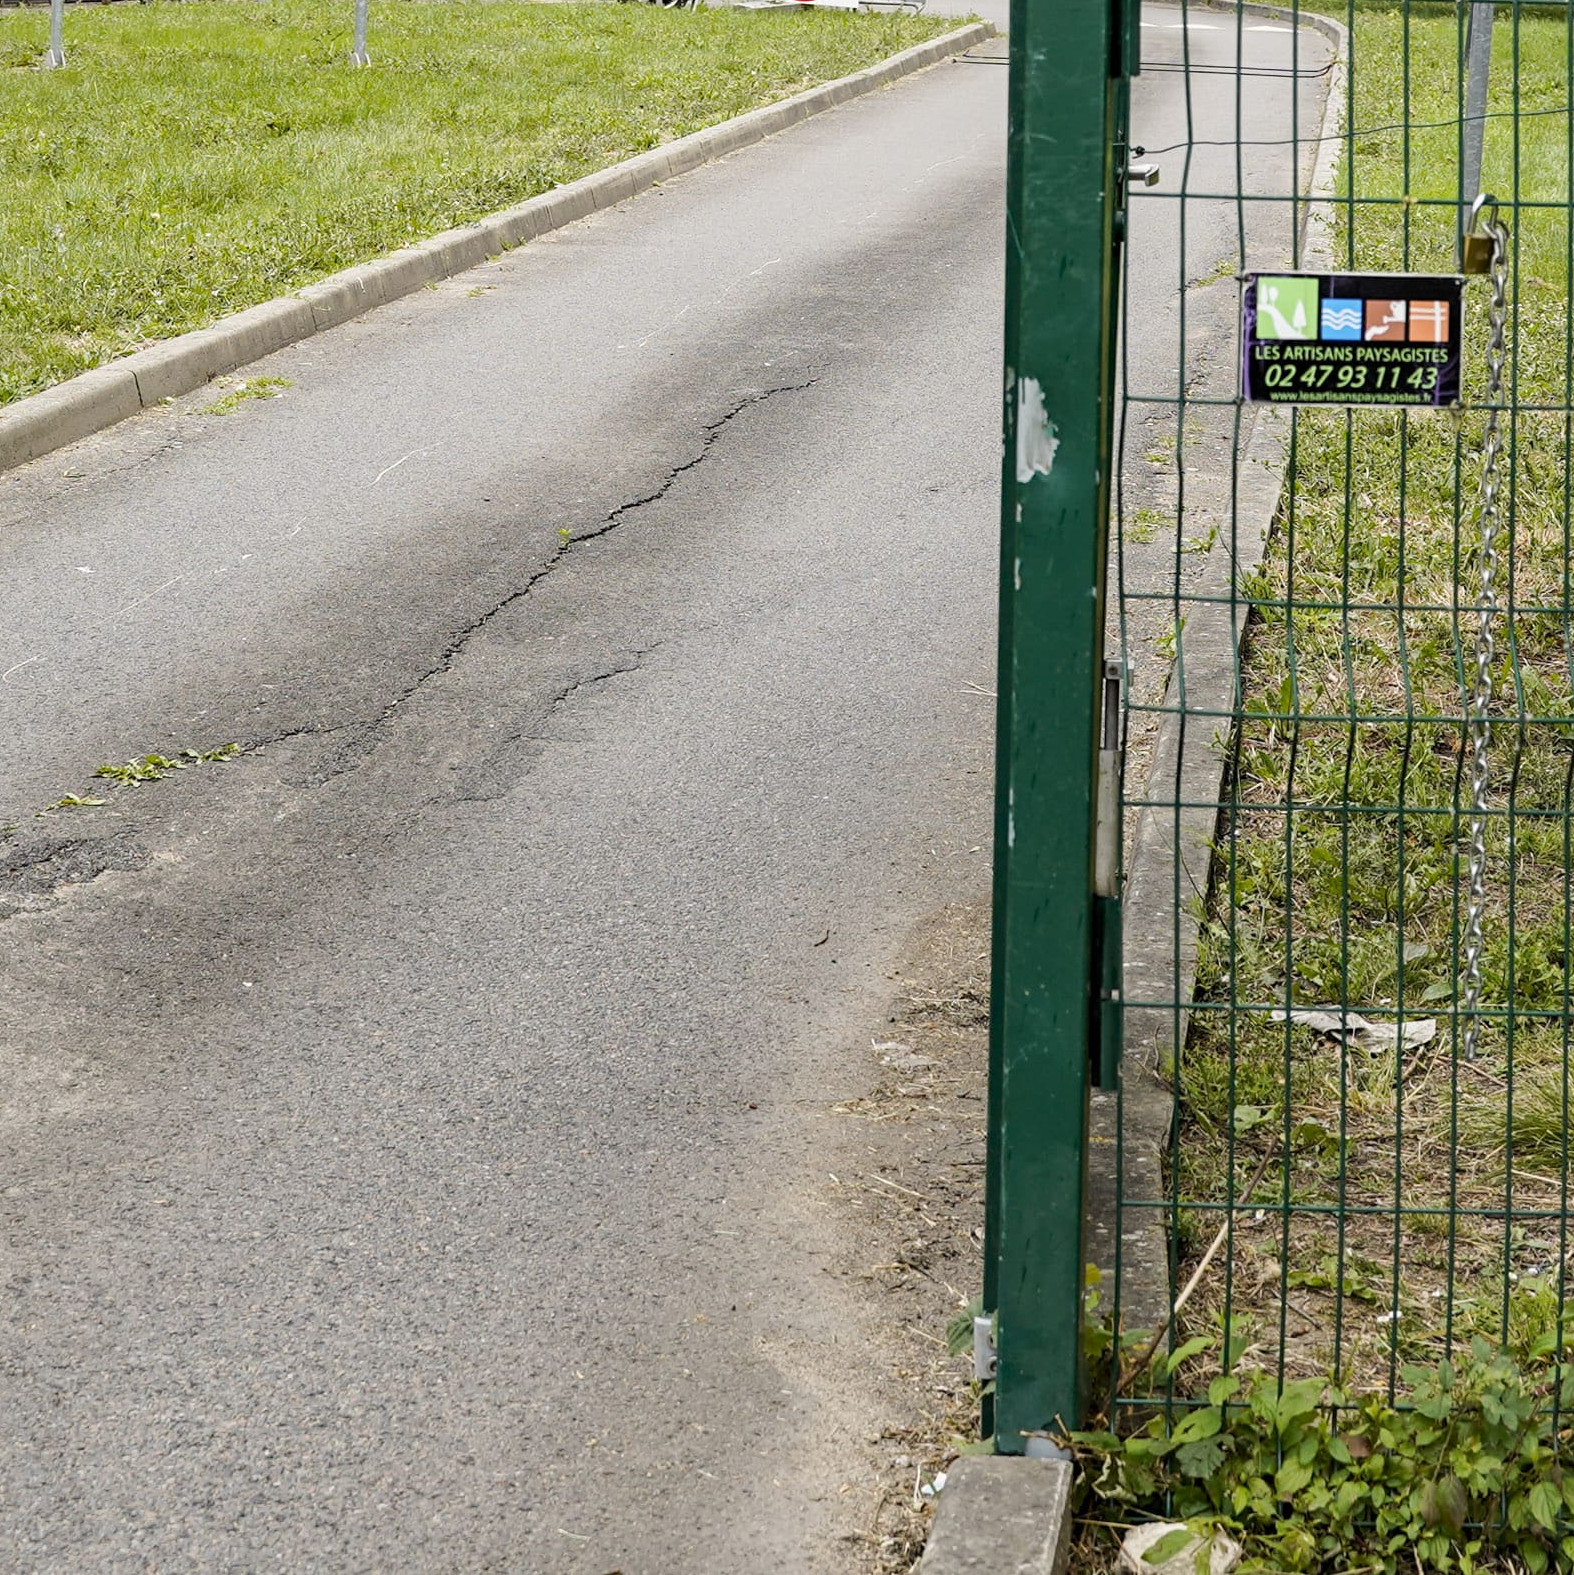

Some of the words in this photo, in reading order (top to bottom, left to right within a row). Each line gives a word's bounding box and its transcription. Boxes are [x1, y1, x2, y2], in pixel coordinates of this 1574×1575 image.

[1255, 346, 1280, 360] LES
[1284, 346, 1353, 361] ARTISANS
[1357, 347, 1448, 363] PAYSAGISTES
[1265, 364, 1296, 386] 02
[1301, 365, 1333, 387] 47
[1337, 366, 1366, 387] 93
[1377, 367, 1399, 388] 11
[1407, 367, 1438, 389] 43
[1270, 390, 1432, 404] www.lesartisanspaysagistes.fr
